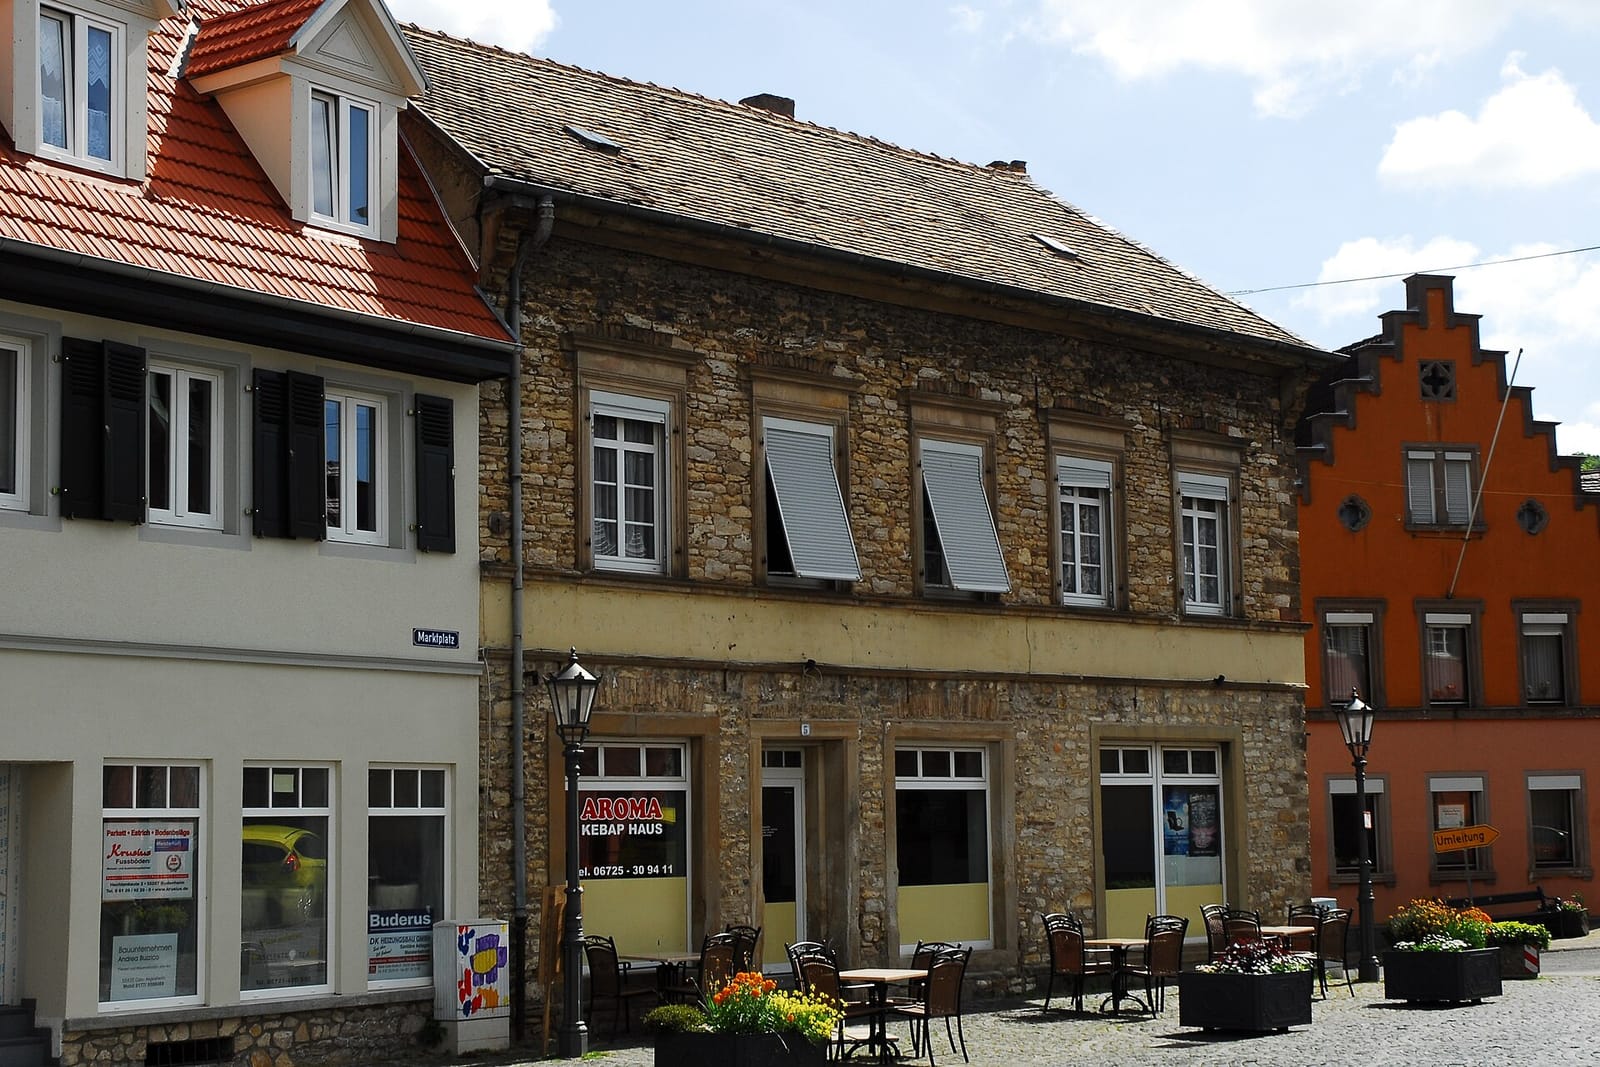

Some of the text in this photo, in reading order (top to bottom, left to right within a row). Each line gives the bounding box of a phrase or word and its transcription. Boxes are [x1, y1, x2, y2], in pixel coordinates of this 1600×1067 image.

[418, 631, 455, 645] Marktplatz
[580, 797, 663, 820] AROMA
[581, 823, 663, 836] KEBAP HAUS
[1437, 832, 1484, 846] Umleitung
[107, 843, 151, 859] Krusius
[578, 867, 590, 877] el.
[593, 866, 624, 876] 06725
[632, 865, 644, 875] 30
[647, 865, 659, 874] 94
[662, 864, 673, 874] 11
[370, 913, 431, 927] Buderus
